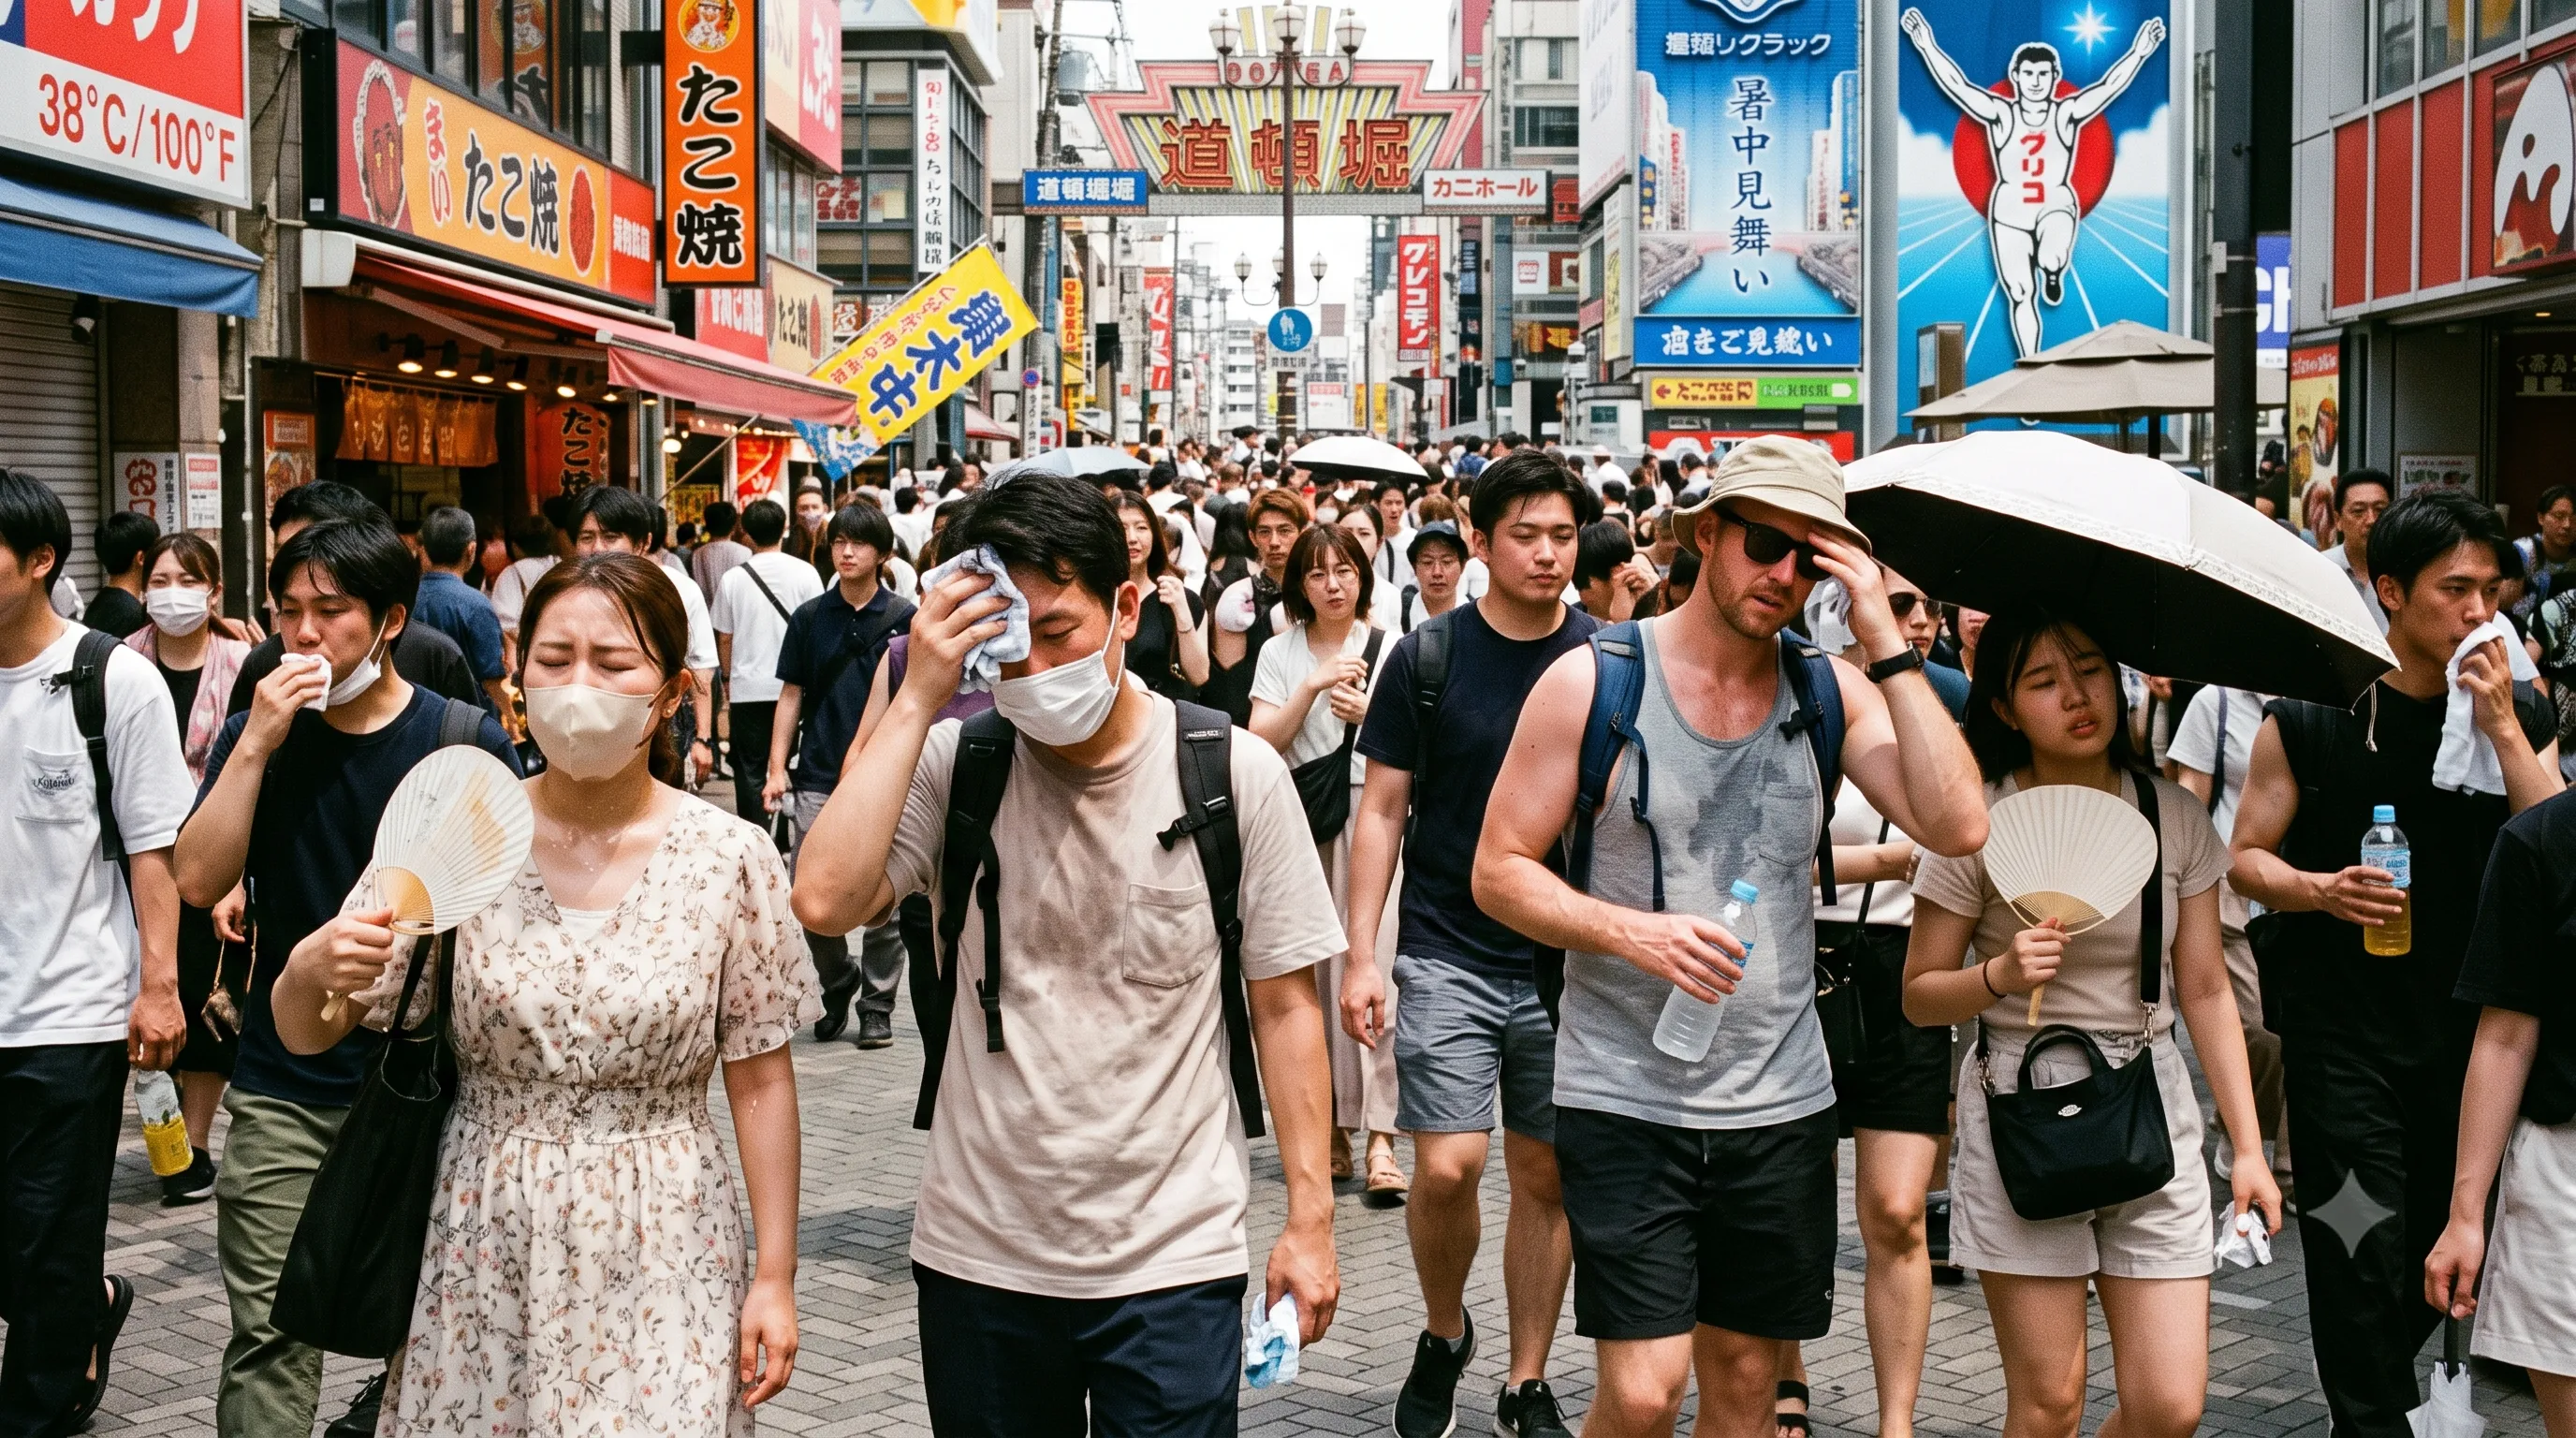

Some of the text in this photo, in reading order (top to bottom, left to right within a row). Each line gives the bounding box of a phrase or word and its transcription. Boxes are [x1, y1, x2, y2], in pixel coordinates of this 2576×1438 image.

[39, 73, 235, 183] 38°C/100°F
[426, 102, 451, 222] まい
[676, 65, 743, 266] たこ焼
[1160, 118, 1410, 188] 道頓堀
[1433, 177, 1539, 198] カニホール
[1730, 80, 1772, 293] 暑中見舞い
[464, 134, 559, 255] たこ焼
